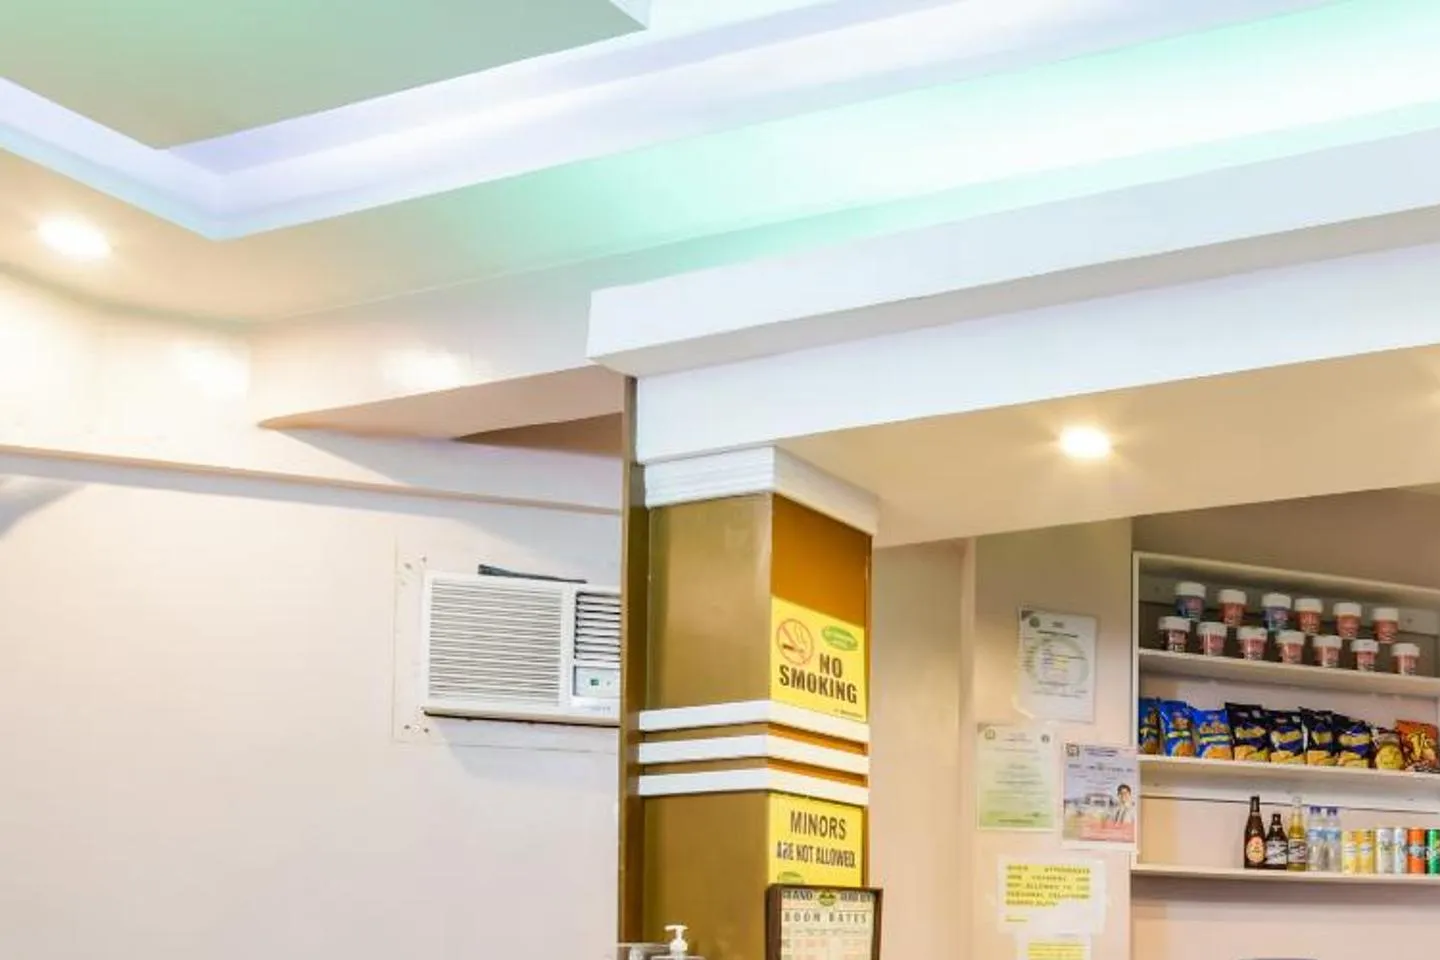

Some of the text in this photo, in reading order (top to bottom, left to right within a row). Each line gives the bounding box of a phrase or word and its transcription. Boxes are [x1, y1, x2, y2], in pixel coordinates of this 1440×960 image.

[819, 653, 843, 679] NO
[779, 664, 857, 704] SMOKING
[790, 809, 846, 840] MINORS
[776, 840, 794, 861] ARE
[796, 844, 814, 863] NOT
